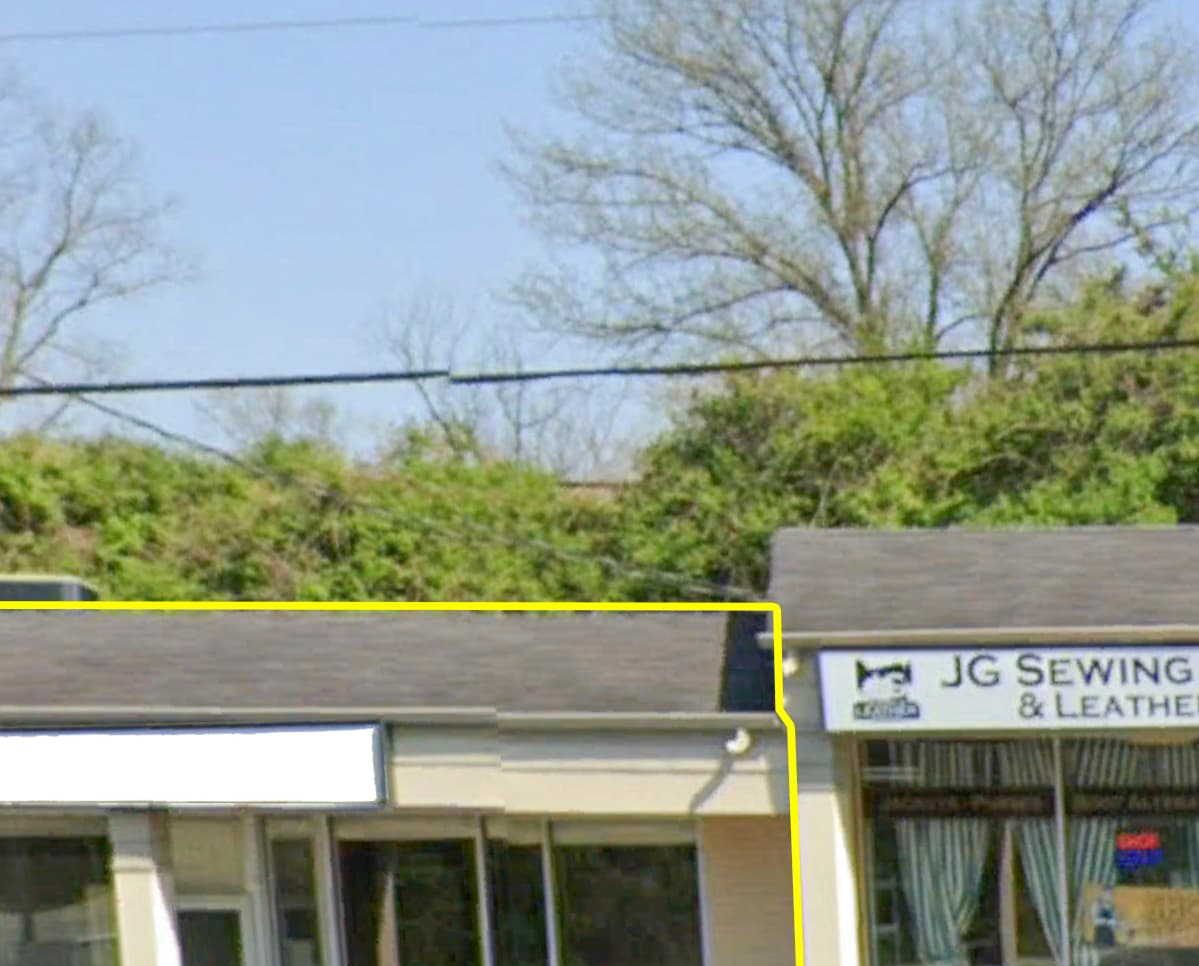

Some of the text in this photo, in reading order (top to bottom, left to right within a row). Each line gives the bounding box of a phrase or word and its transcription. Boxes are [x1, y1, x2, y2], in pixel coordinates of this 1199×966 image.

[941, 653, 1192, 687] JG SEWING
[1018, 692, 1199, 719] & LEATHE
